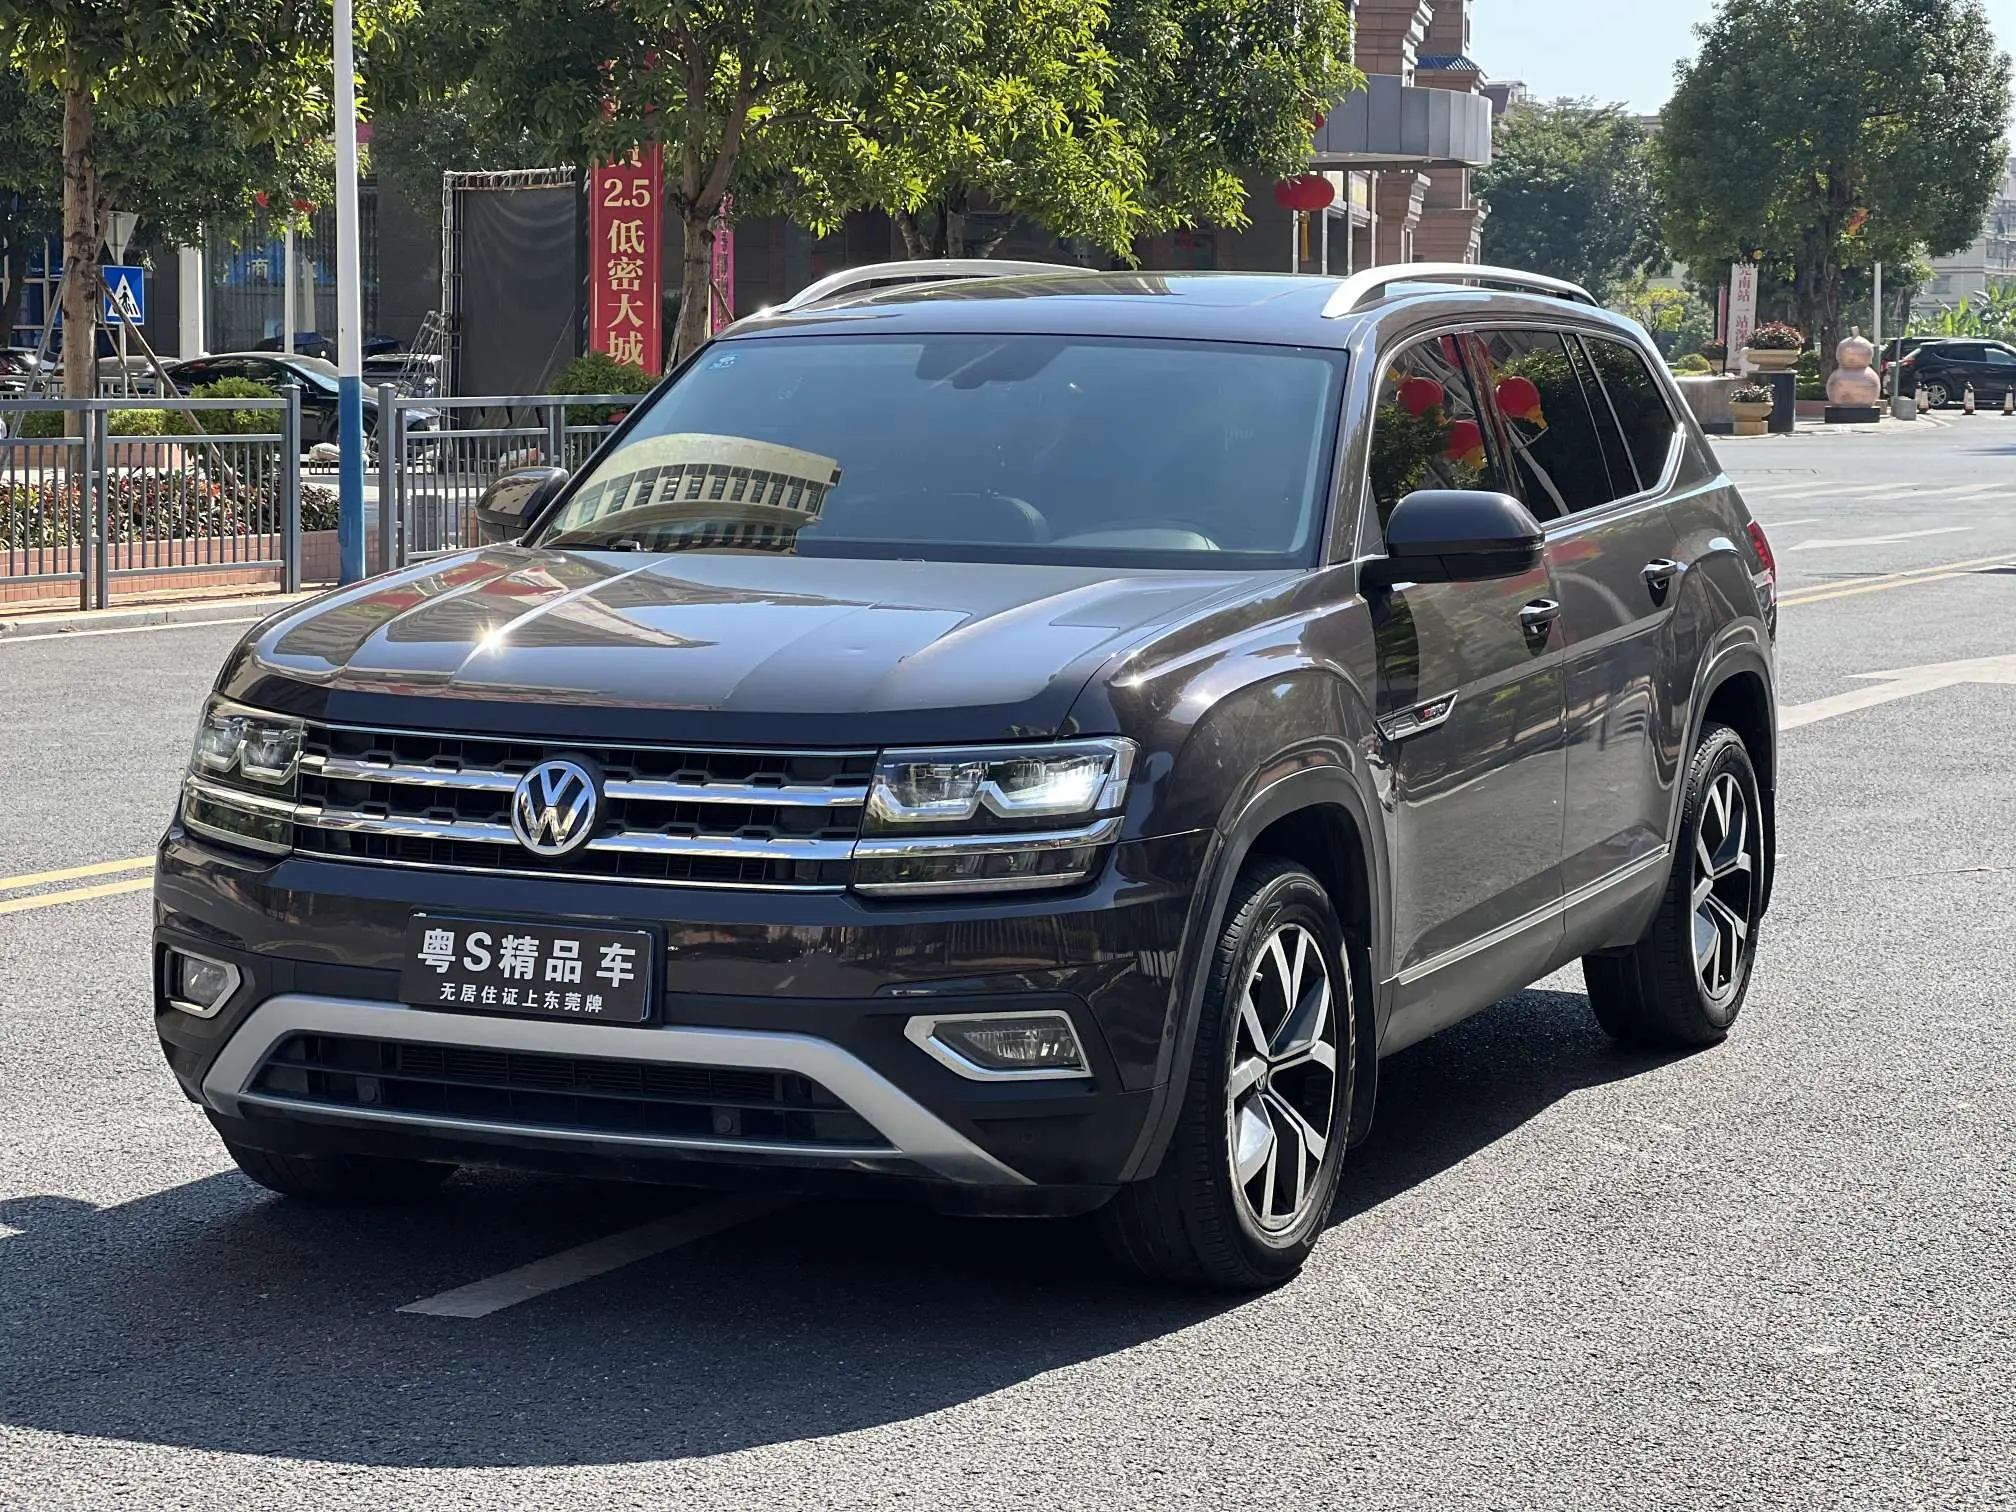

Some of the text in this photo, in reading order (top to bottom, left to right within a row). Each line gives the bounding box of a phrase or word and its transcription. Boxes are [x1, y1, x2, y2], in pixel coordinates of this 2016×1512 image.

[604, 178, 651, 207] 2.5
[607, 218, 645, 366] 低密大城
[417, 928, 636, 988] 粤S精品车
[439, 982, 603, 1013] 无居住证上东莞牌
